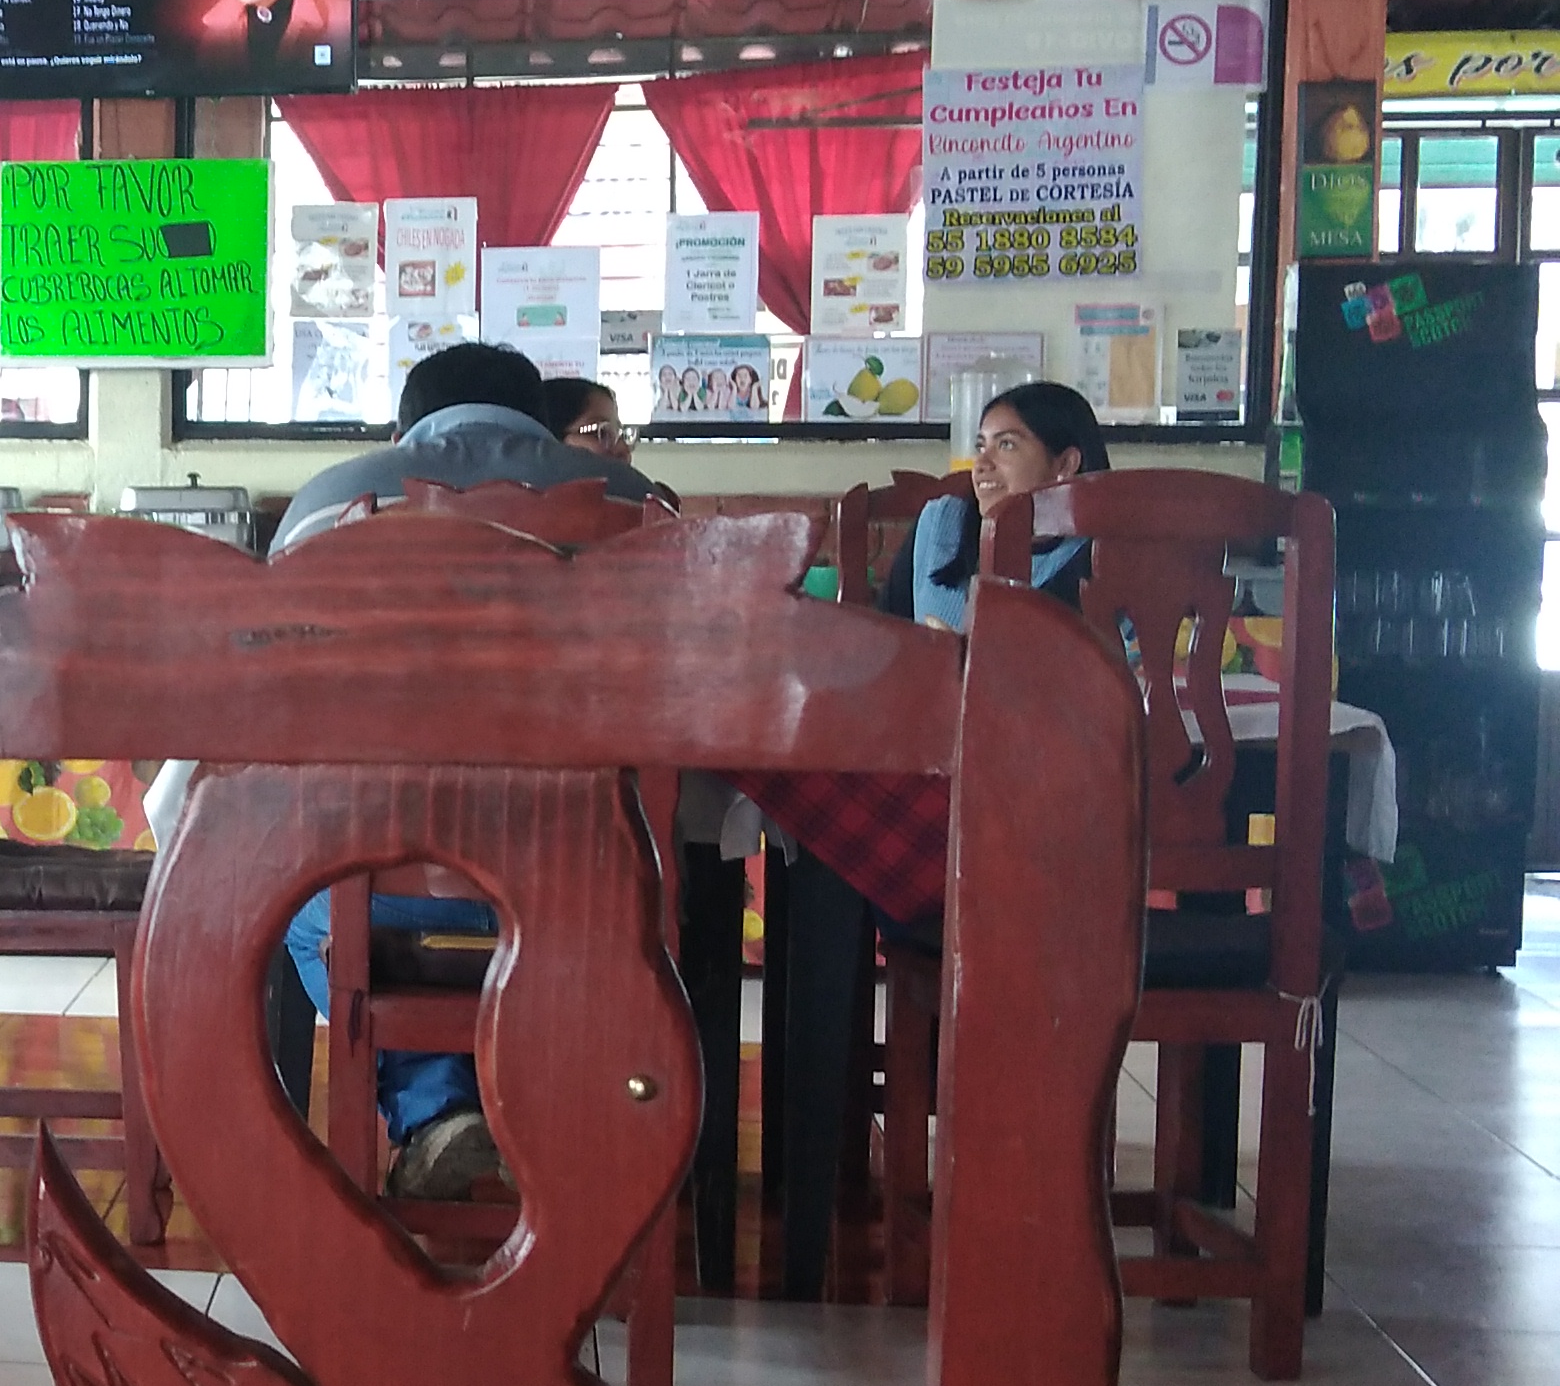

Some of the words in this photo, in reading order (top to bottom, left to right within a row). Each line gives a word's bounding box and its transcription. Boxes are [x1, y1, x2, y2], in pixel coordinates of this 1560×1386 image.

[966, 70, 1063, 96] Festeja
[1074, 68, 1102, 88] Tu
[929, 97, 1094, 129] Cumpleaños
[1103, 97, 1138, 118] En
[928, 132, 1027, 155] Rinconcito
[1039, 130, 1136, 158] Argentino
[940, 166, 951, 181] A
[958, 164, 1005, 184] partir
[1010, 163, 1030, 179] de
[1036, 163, 1046, 179] 5
[1052, 164, 1126, 182] personas
[5, 164, 74, 212] POR
[86, 163, 206, 217] FAVOR
[930, 186, 1003, 205] PASTEL
[1009, 188, 1030, 202] DE
[1036, 177, 1134, 202] CORTESÍA
[942, 207, 1096, 228] Reservaciones
[1100, 202, 1122, 223] al
[2, 222, 106, 268] TRAER
[926, 228, 965, 253] 55
[975, 226, 1051, 253] 1880
[1059, 224, 1139, 251] 8584
[693, 269, 721, 278] Jarra
[926, 255, 965, 280] 59
[973, 252, 1051, 279] 5955
[1058, 250, 1138, 276] 6925
[2, 270, 152, 305] CUBREBOCAS
[6, 314, 45, 346] LOS
[62, 306, 224, 351] ALIMENTOS
[609, 333, 634, 343] VISA
[1183, 392, 1207, 403] VISA
